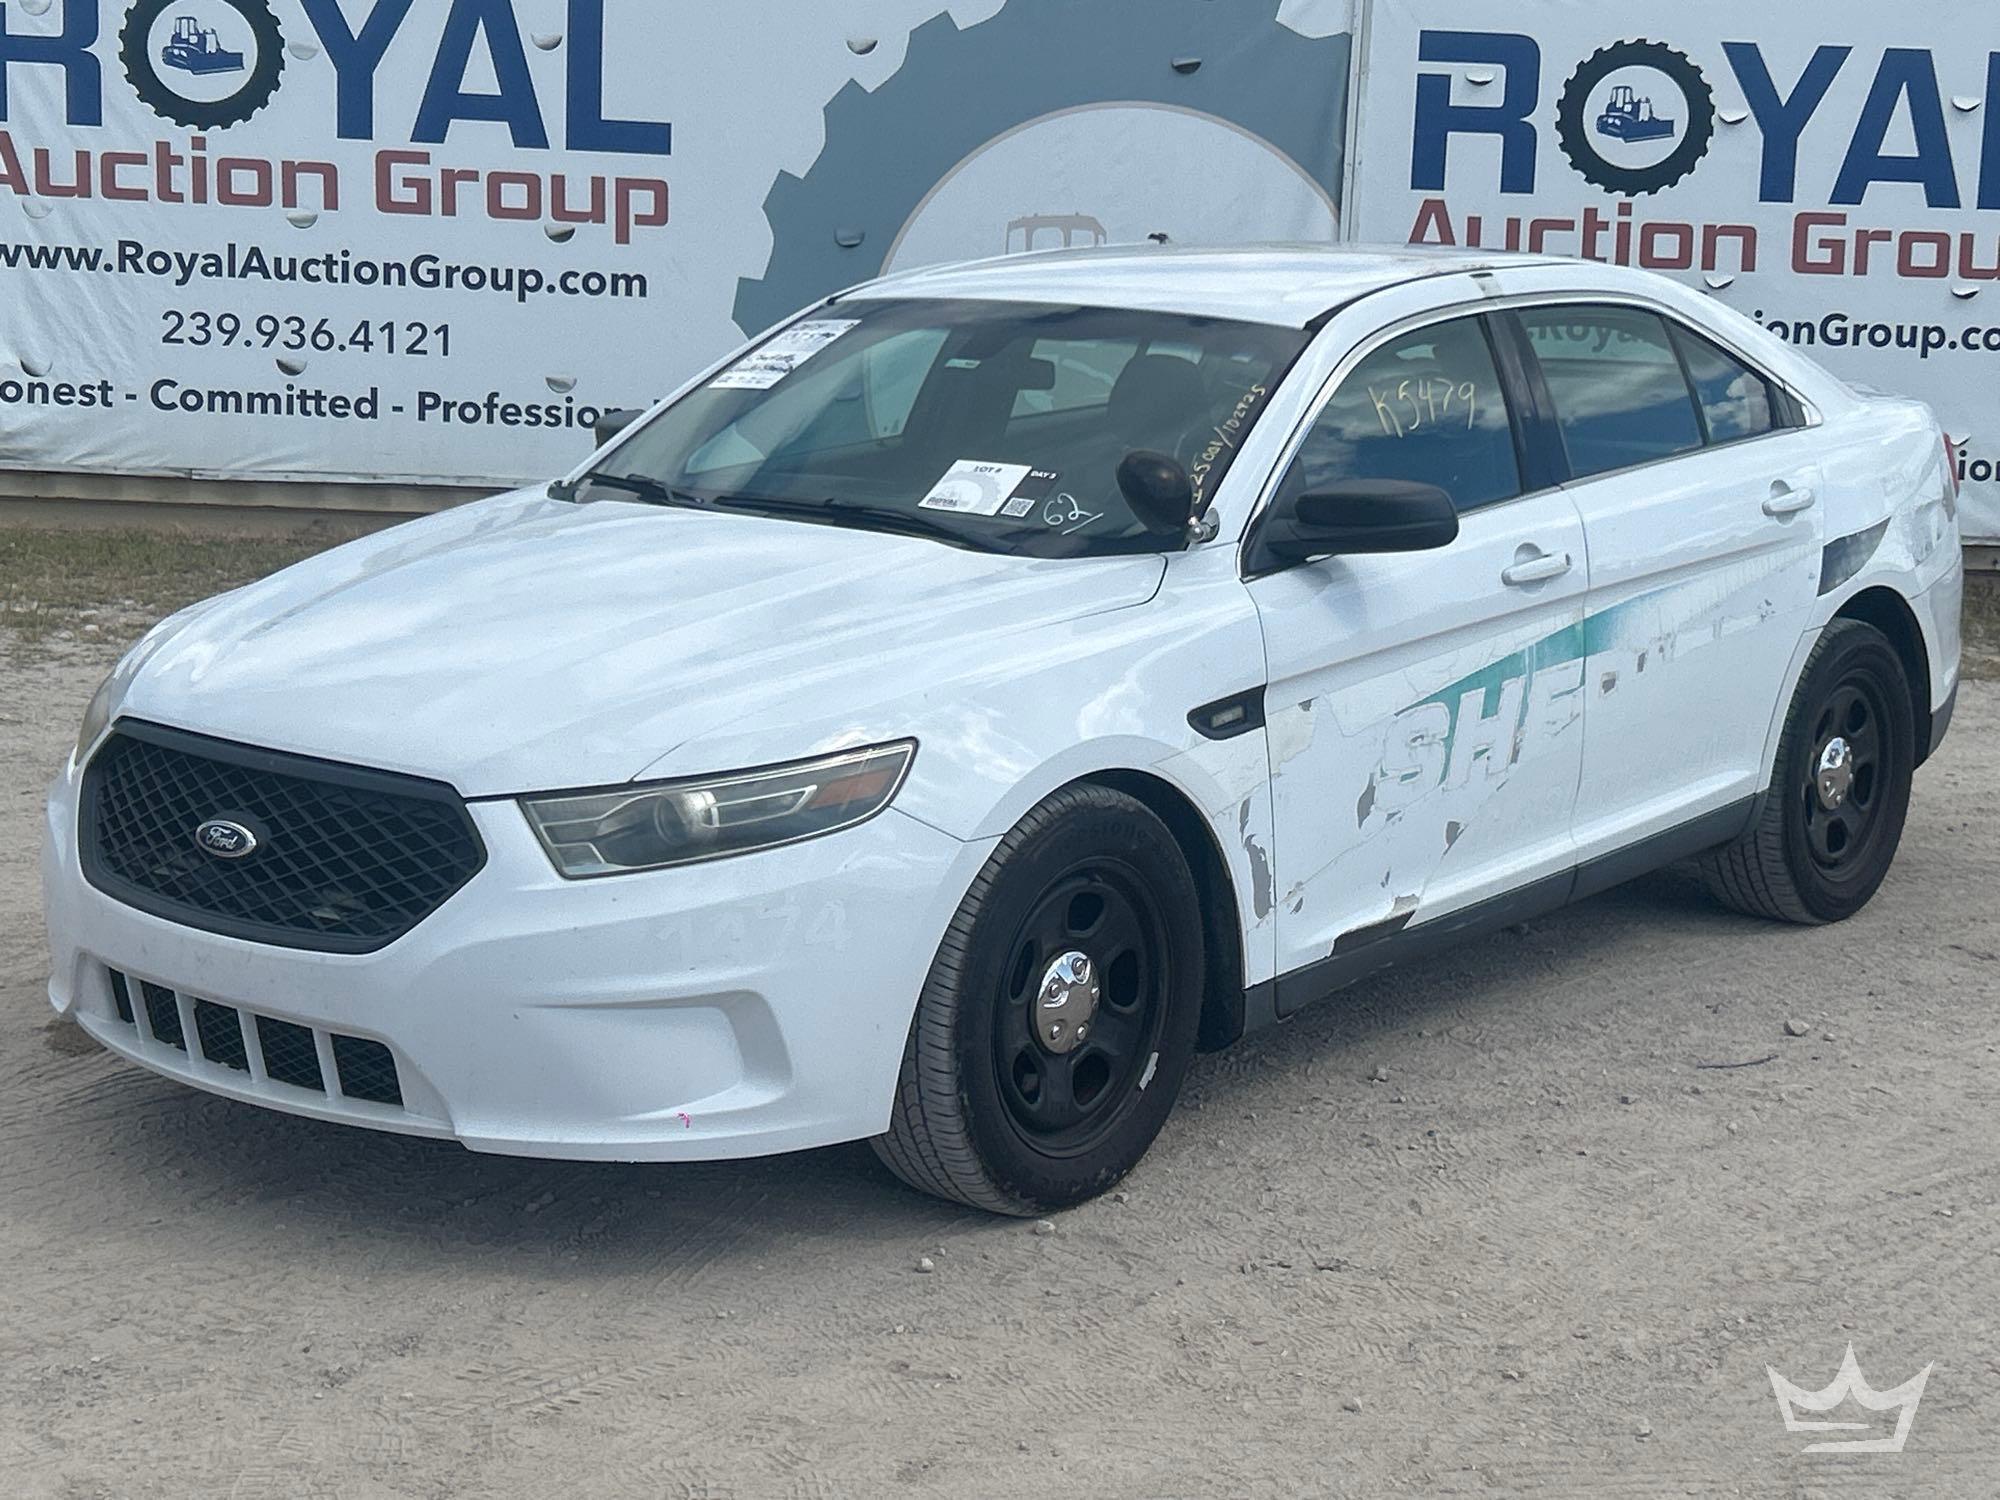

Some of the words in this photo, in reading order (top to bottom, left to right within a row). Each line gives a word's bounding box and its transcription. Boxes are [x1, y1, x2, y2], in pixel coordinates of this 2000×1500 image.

[1411, 30, 2000, 210] ROYA
[375, 149, 669, 244] Group
[0, 239, 648, 302] www.RoyalAuctionGroup.com
[161, 310, 451, 356] 239.936.4121
[150, 378, 379, 421] Committed
[1368, 379, 1475, 438] K5479
[1042, 492, 1093, 526] 62
[206, 826, 238, 850] Ford
